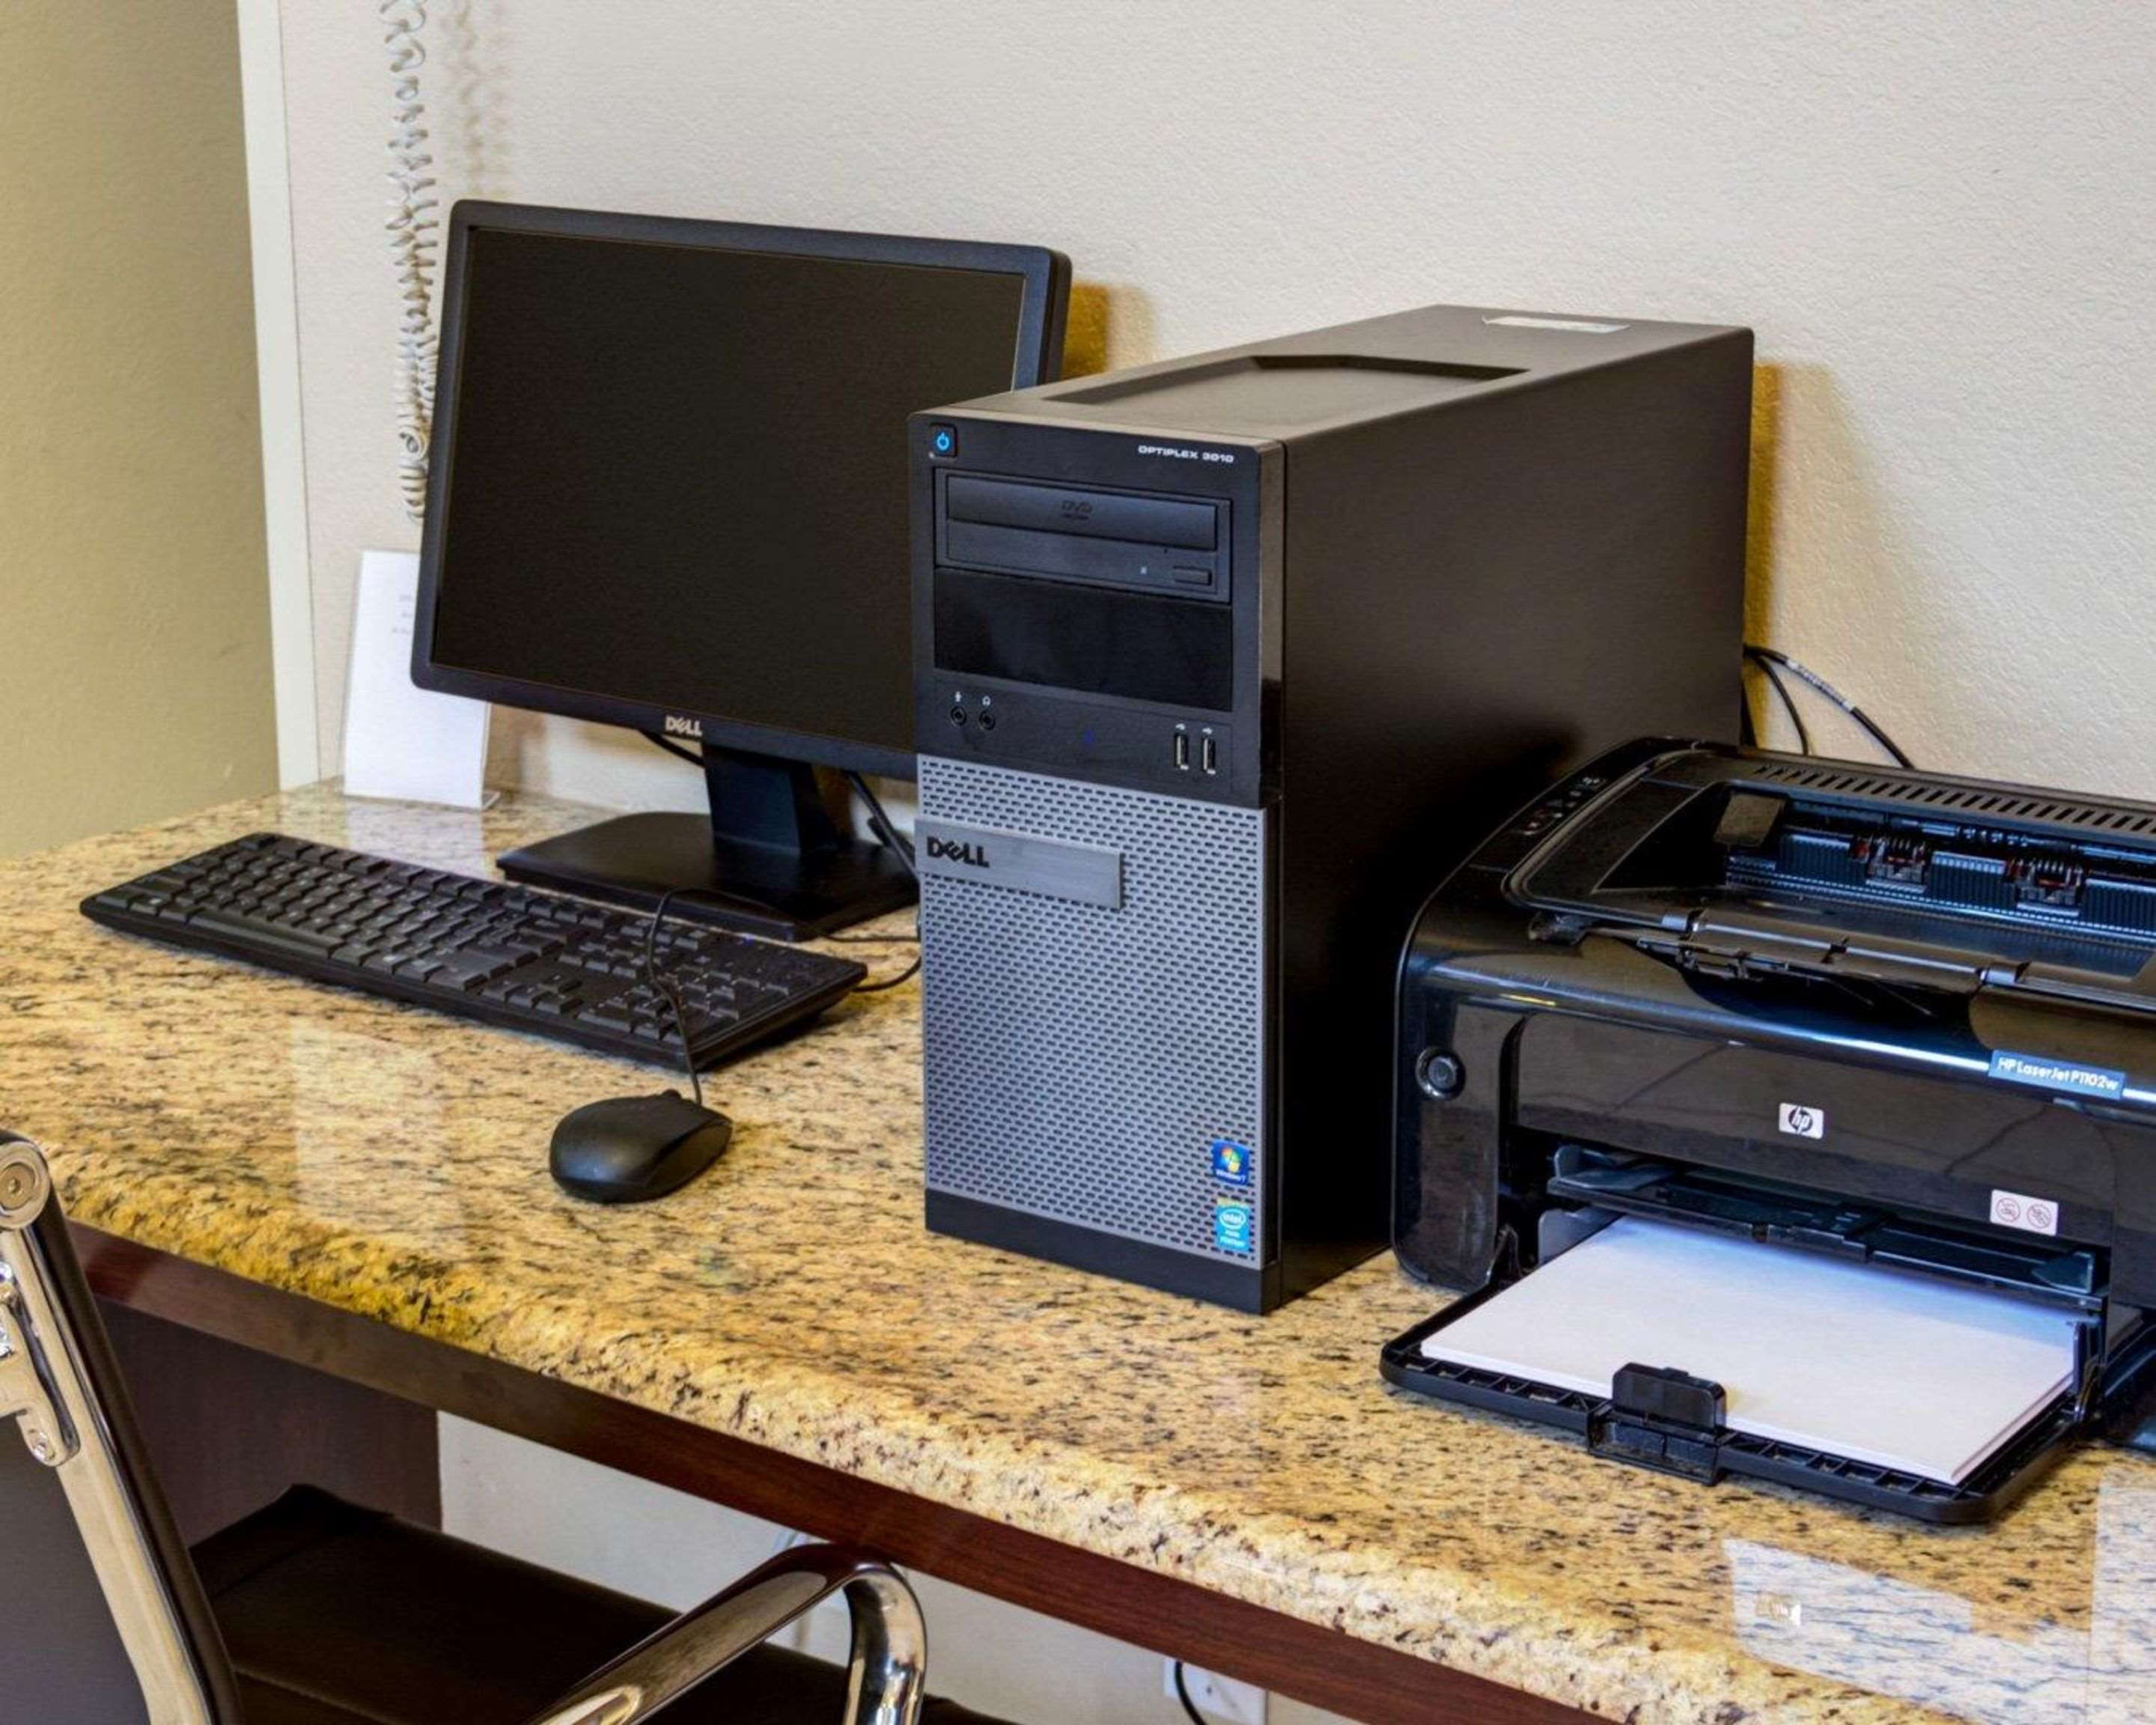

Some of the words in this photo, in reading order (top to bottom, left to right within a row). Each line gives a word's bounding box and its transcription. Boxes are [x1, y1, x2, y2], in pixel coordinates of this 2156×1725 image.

[1138, 445, 1199, 459] OPTIPLEX
[665, 715, 703, 736] DELL
[927, 836, 990, 868] DELL
[1997, 1056, 2016, 1071] HP
[2017, 1061, 2071, 1083] LaserJet
[2071, 1068, 2120, 1091] P1102w
